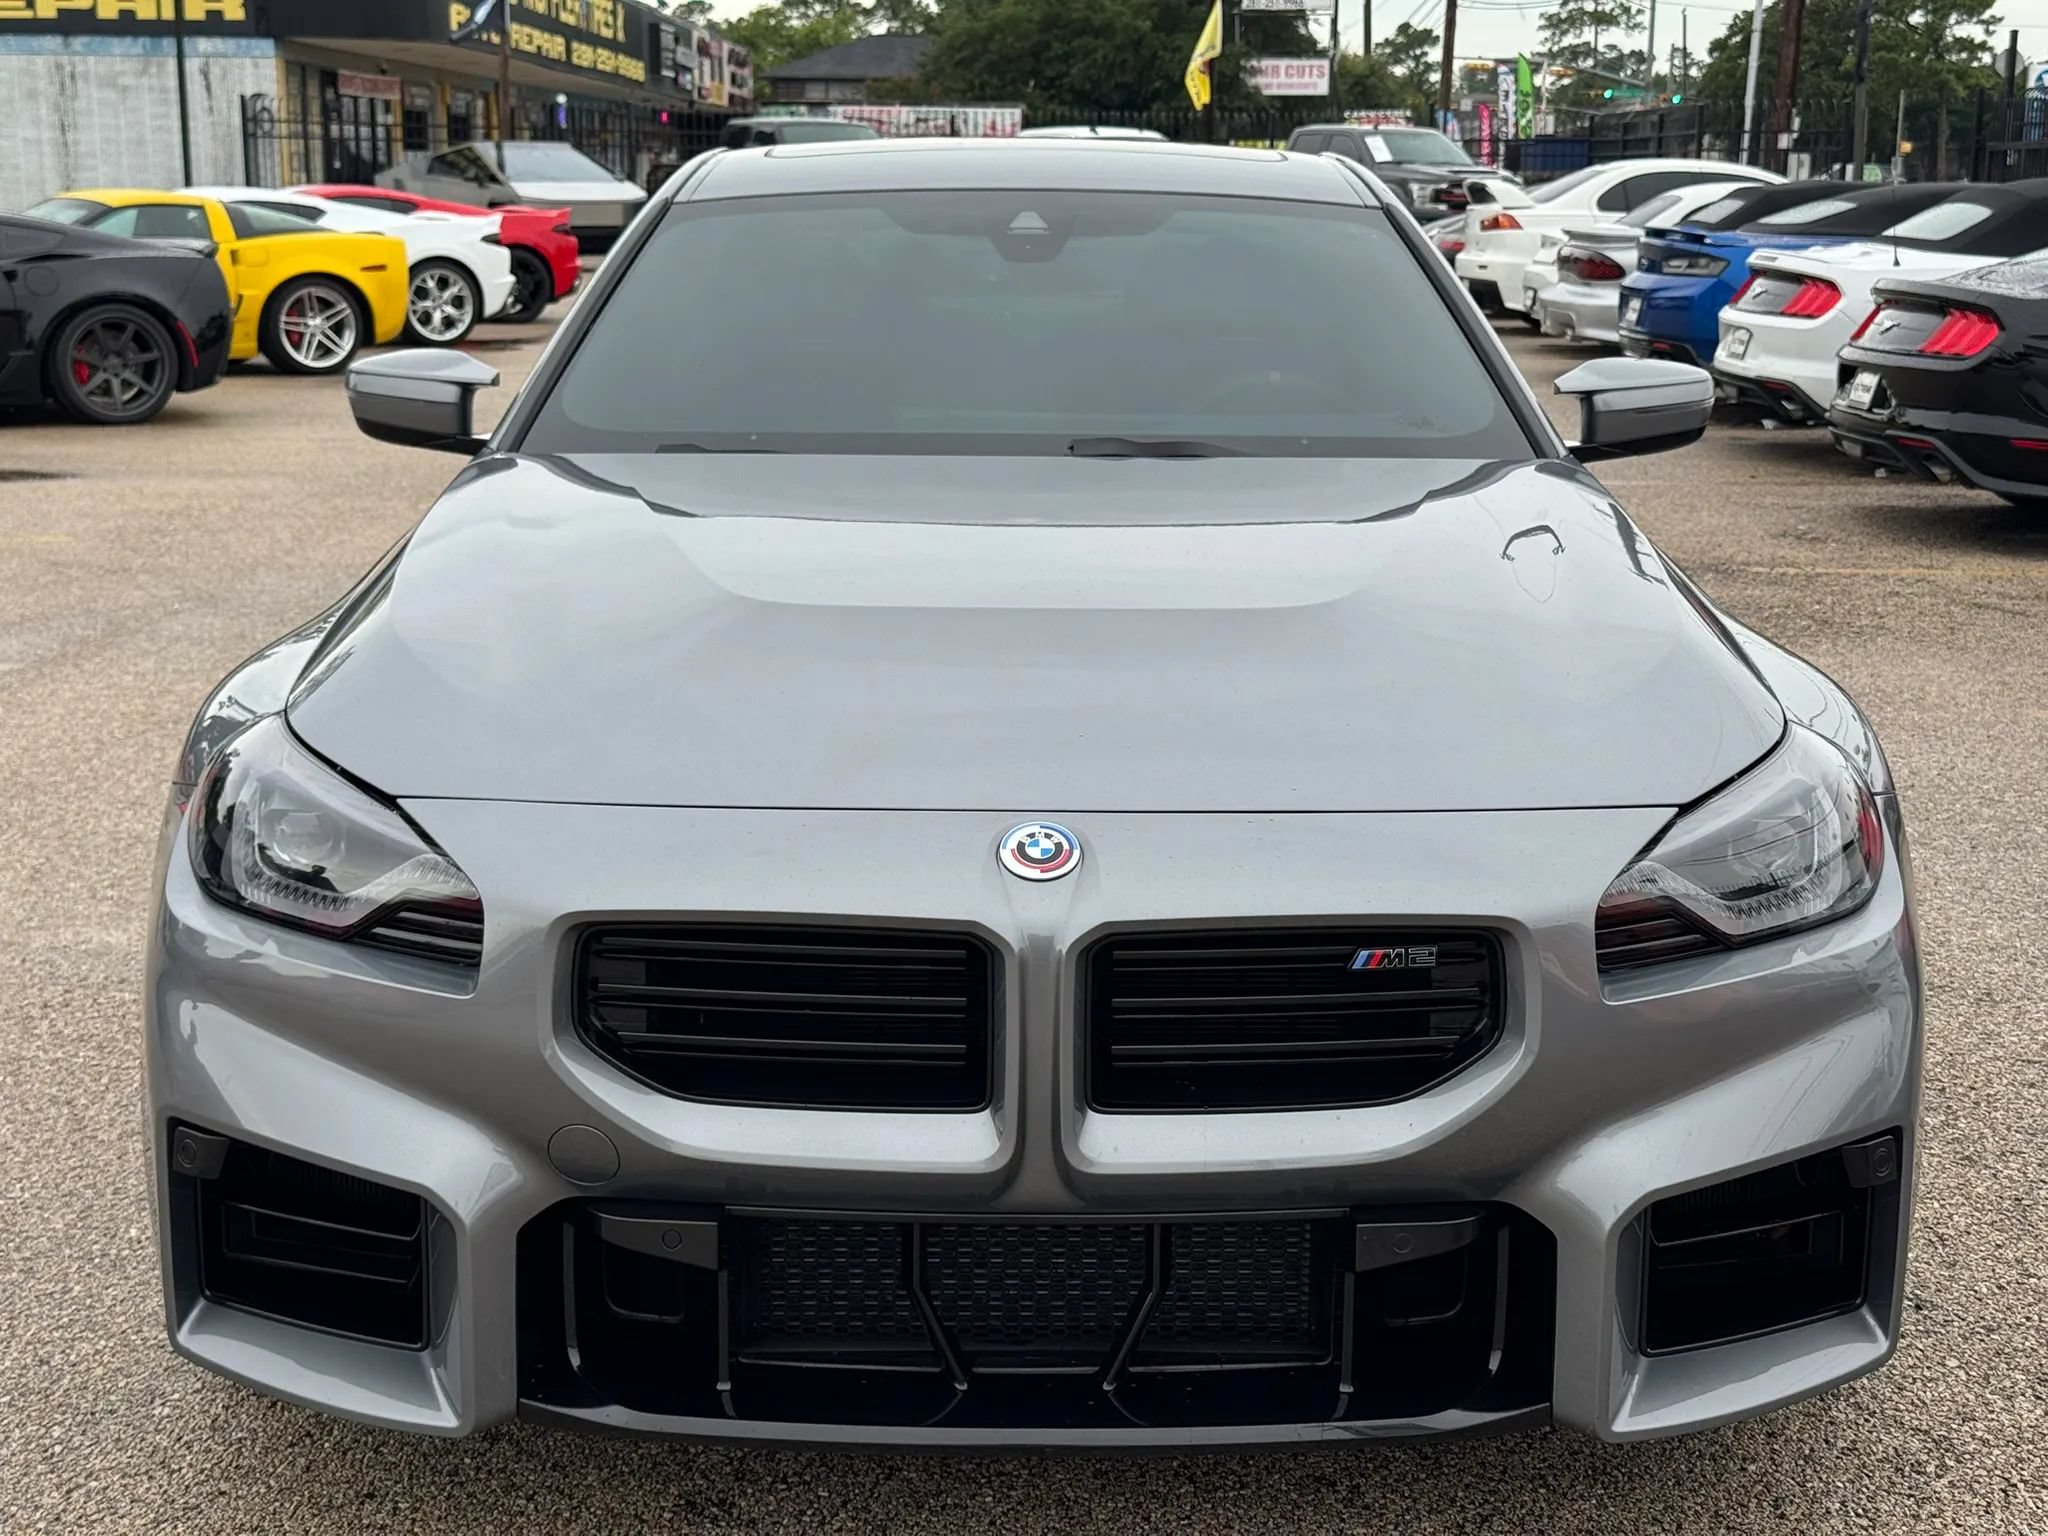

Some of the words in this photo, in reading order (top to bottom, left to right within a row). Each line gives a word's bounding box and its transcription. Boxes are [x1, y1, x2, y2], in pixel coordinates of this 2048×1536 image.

[510, 22, 566, 60] REPAIR
[1284, 64, 1326, 79] CUTS
[1020, 831, 1061, 843] BMW
